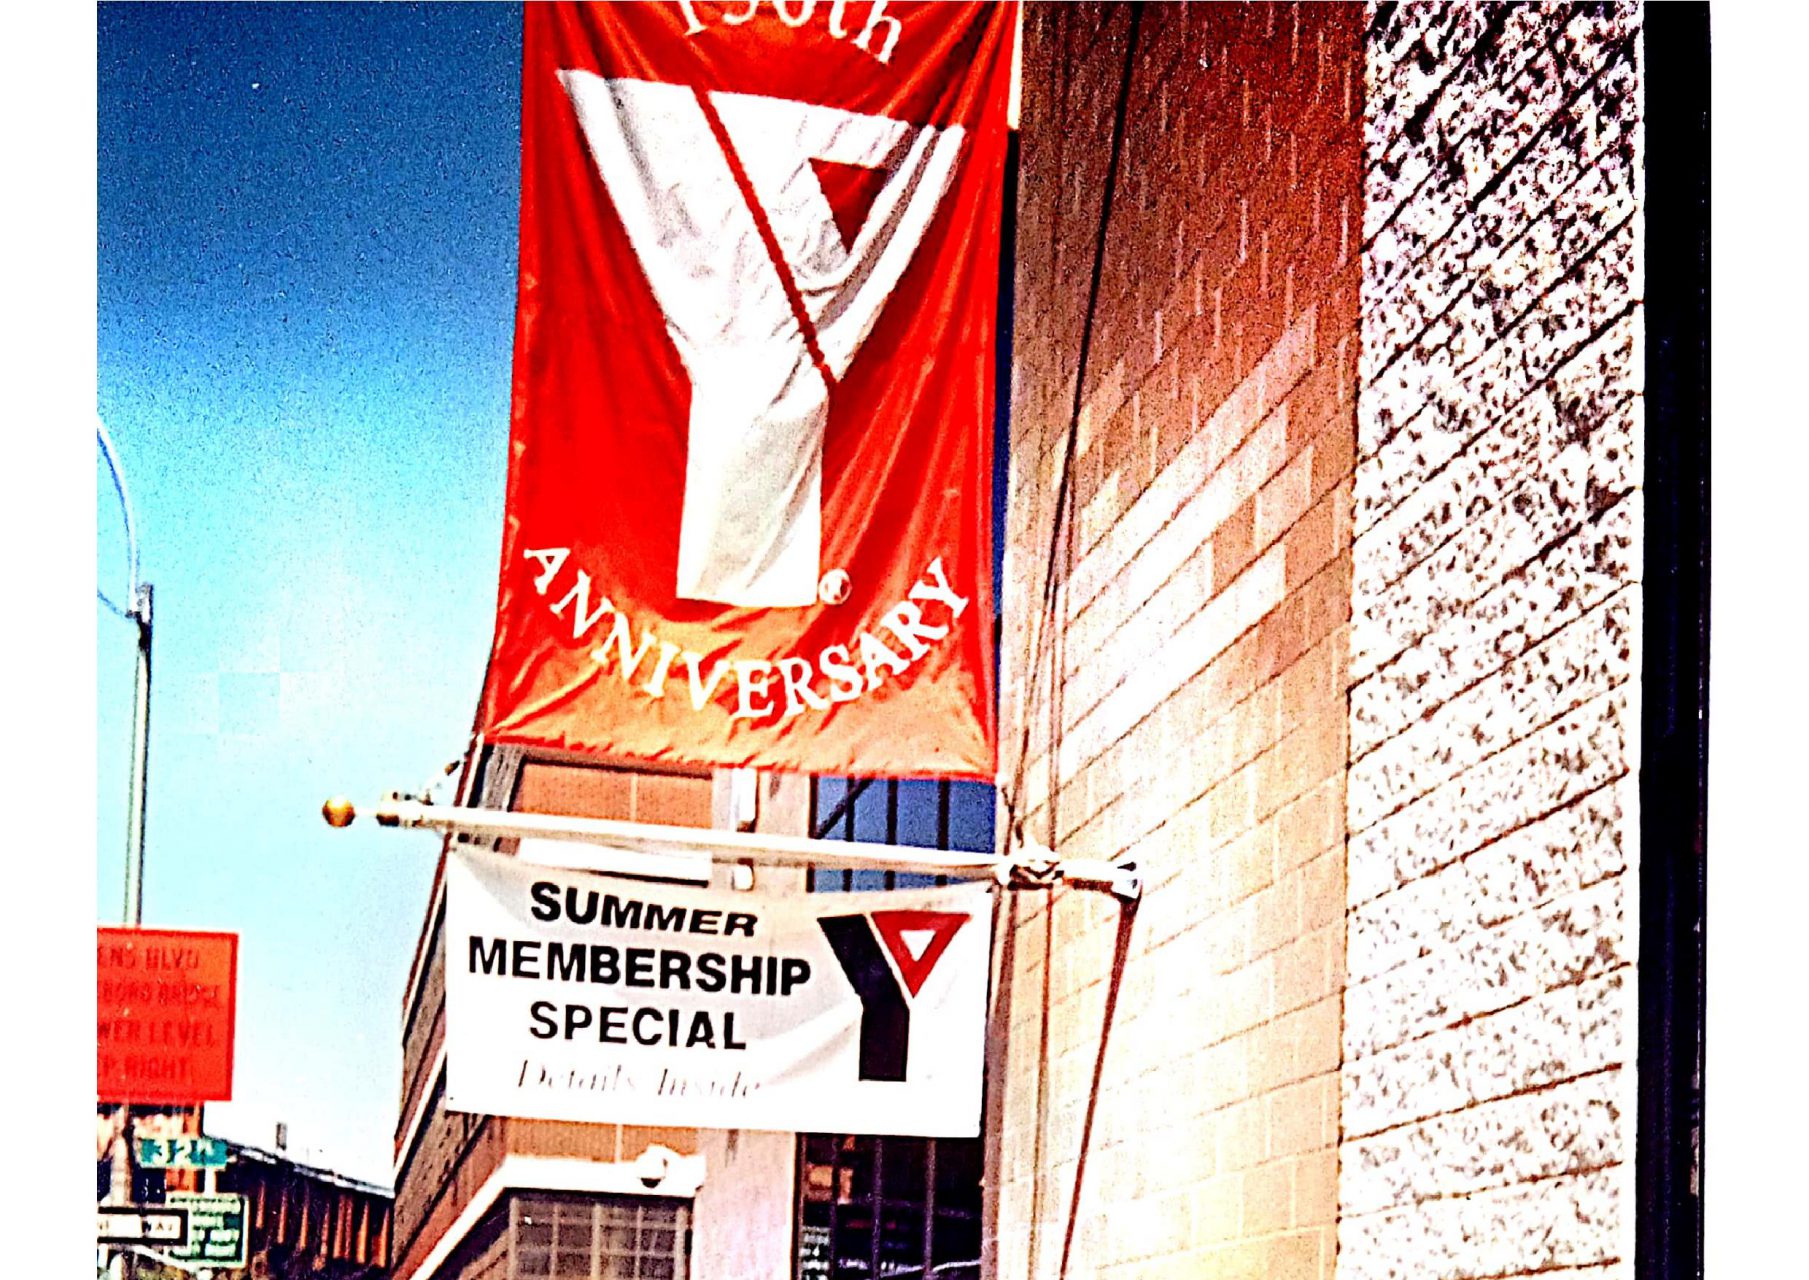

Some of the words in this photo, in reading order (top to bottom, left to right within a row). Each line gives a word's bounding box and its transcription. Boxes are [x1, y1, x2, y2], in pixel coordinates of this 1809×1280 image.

[523, 547, 969, 718] ANNIVERSARY
[530, 880, 758, 938] SUMMER
[469, 936, 811, 997] MEMBERSHIP
[529, 1001, 747, 1050] SPECIAL
